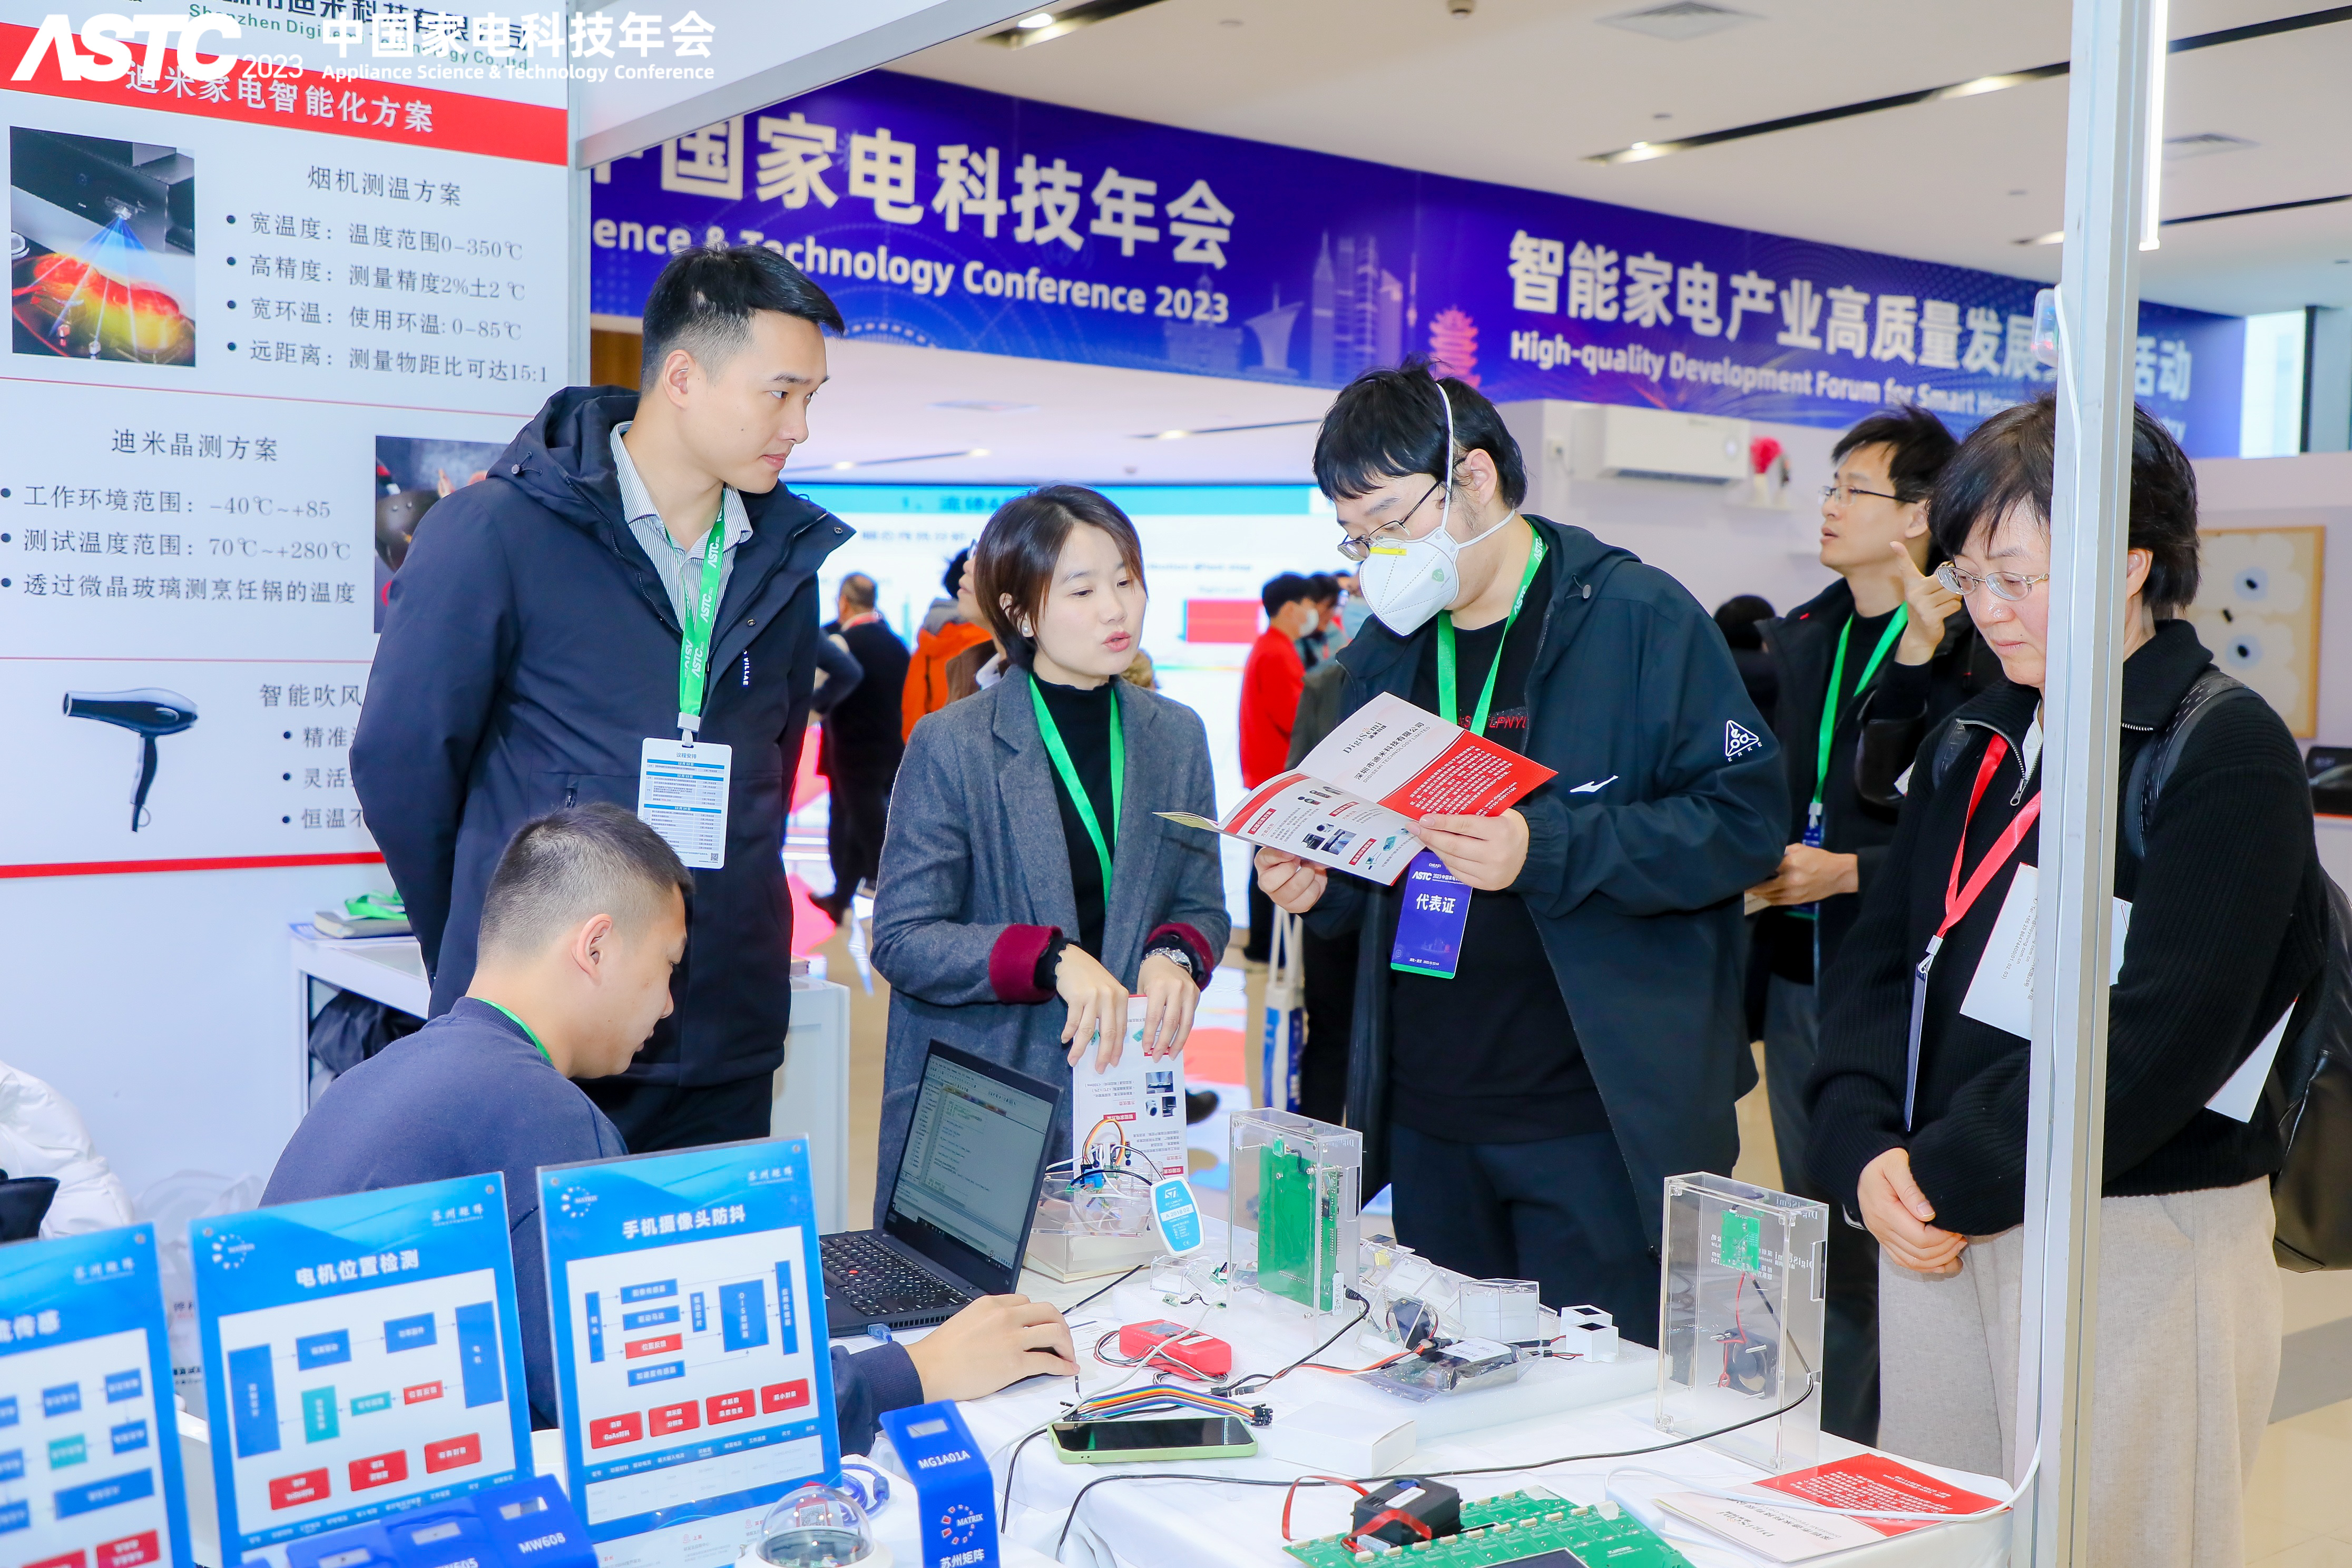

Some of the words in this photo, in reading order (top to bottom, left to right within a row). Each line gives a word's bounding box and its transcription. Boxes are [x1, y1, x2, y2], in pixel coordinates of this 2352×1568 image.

[125, 60, 433, 133] 迪米家电智能化方案
[307, 164, 462, 207] 烟机测温方案
[594, 112, 1235, 270] 国家电科技年会
[963, 260, 1147, 315] Conference
[1154, 286, 1230, 325] 2023
[1510, 330, 1665, 383] High-quality
[1669, 351, 1812, 397] Development
[1816, 370, 1880, 403] Forum
[1916, 383, 1976, 415] Smart
[111, 429, 278, 463] 迪米晶测方案
[24, 573, 356, 605] 透过微晶玻璃测烹饪锅的温度
[700, 593, 712, 623] ASTC
[691, 647, 703, 679] ASTC
[303, 726, 357, 748] 精准
[1342, 721, 1383, 754] DigiSemi
[1354, 721, 1425, 780] 深圳市迪米科技有限公司
[1728, 741, 1762, 762] ERKE
[1363, 763, 1384, 783] DIGISEMI
[1383, 739, 1412, 765] TECHNOLOGY
[1412, 726, 1431, 741] LIMITED
[303, 767, 354, 790] 灵活
[1412, 871, 1433, 881] ASTC
[1416, 893, 1456, 914] 代表证
[622, 1203, 747, 1240] 手机摄像头防抖
[295, 1248, 420, 1289] 电机位置检测
[917, 1449, 971, 1471] MG1A01A
[956, 1512, 984, 1528] MATRIX
[518, 1532, 567, 1554] MW608
[939, 1547, 985, 1568] 苏州矩阵
